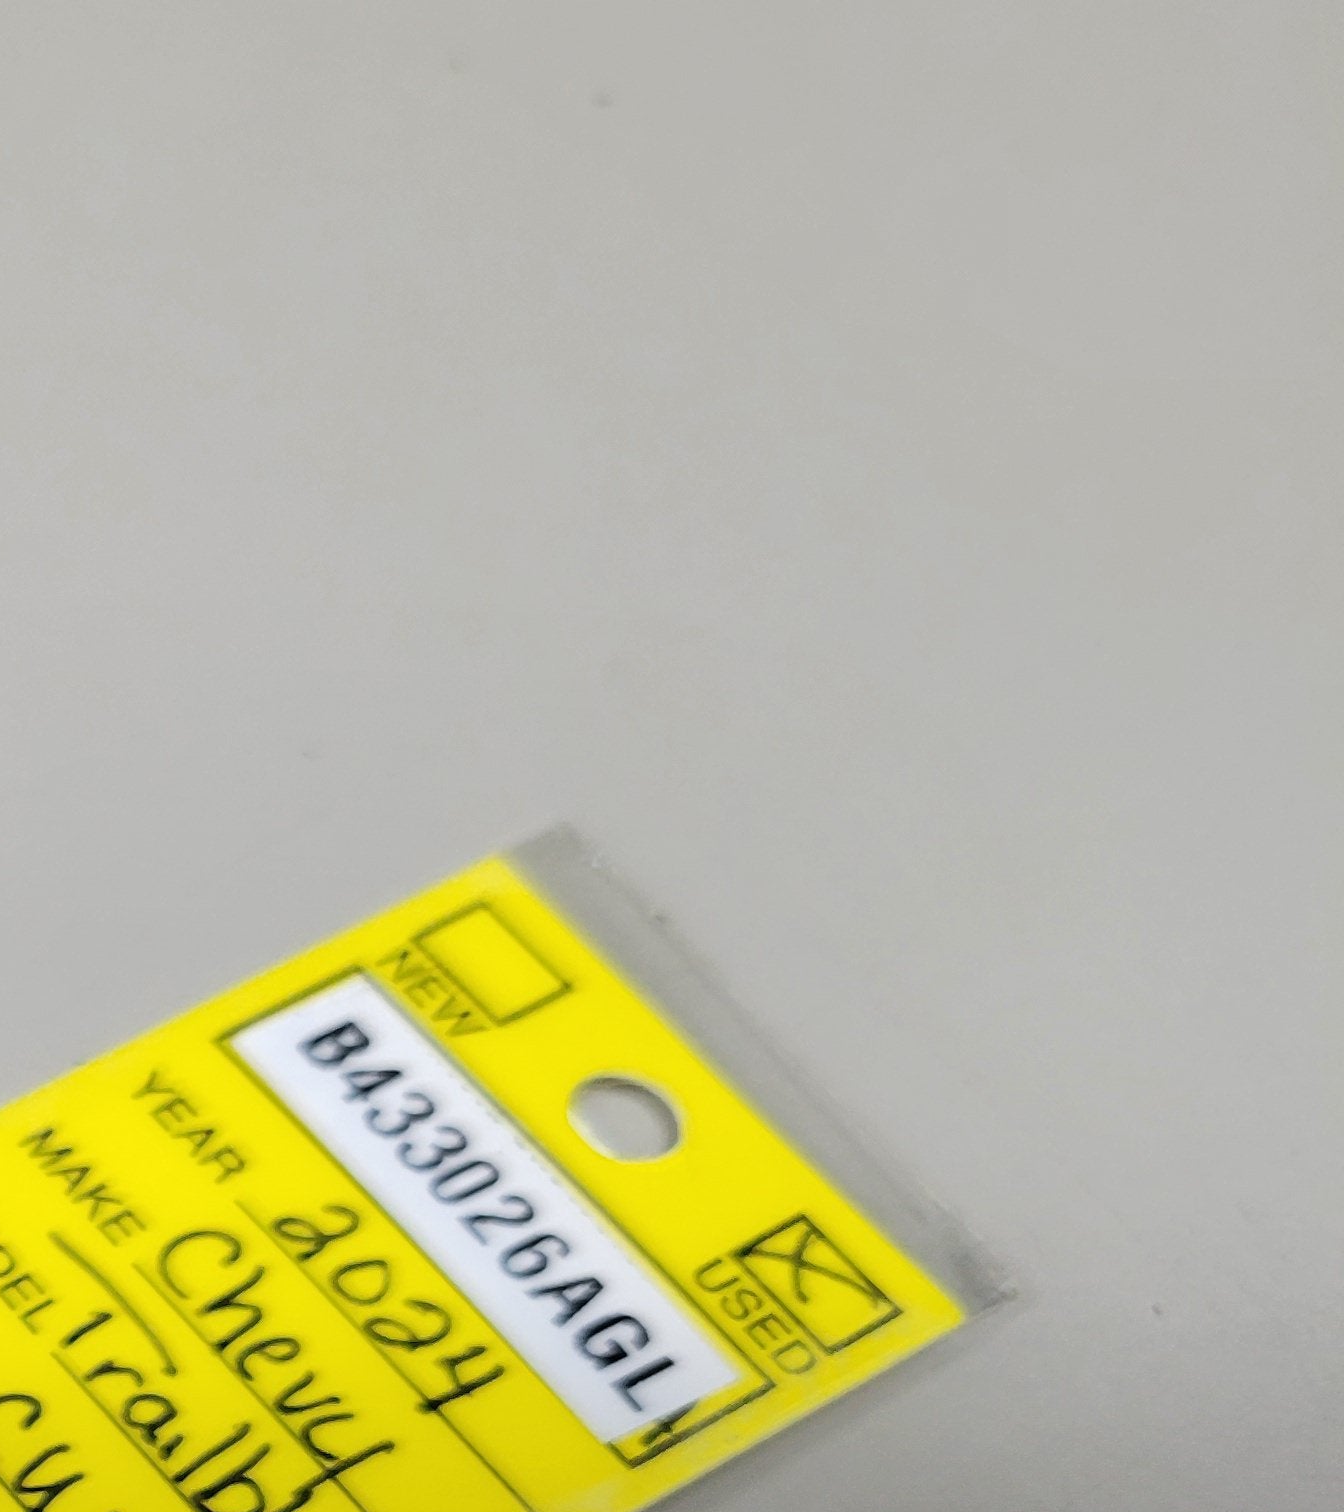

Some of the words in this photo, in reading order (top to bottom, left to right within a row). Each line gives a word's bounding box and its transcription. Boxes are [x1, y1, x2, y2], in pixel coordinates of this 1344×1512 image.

[377, 948, 488, 1038] NEW
[18, 1127, 147, 1246] MAKE
[157, 1229, 396, 1502] Chevy
[131, 1069, 246, 1184] YEAR
[272, 1204, 504, 1414] 2024
[298, 1020, 676, 1413] B433026AGL
[692, 1256, 819, 1376] USED
